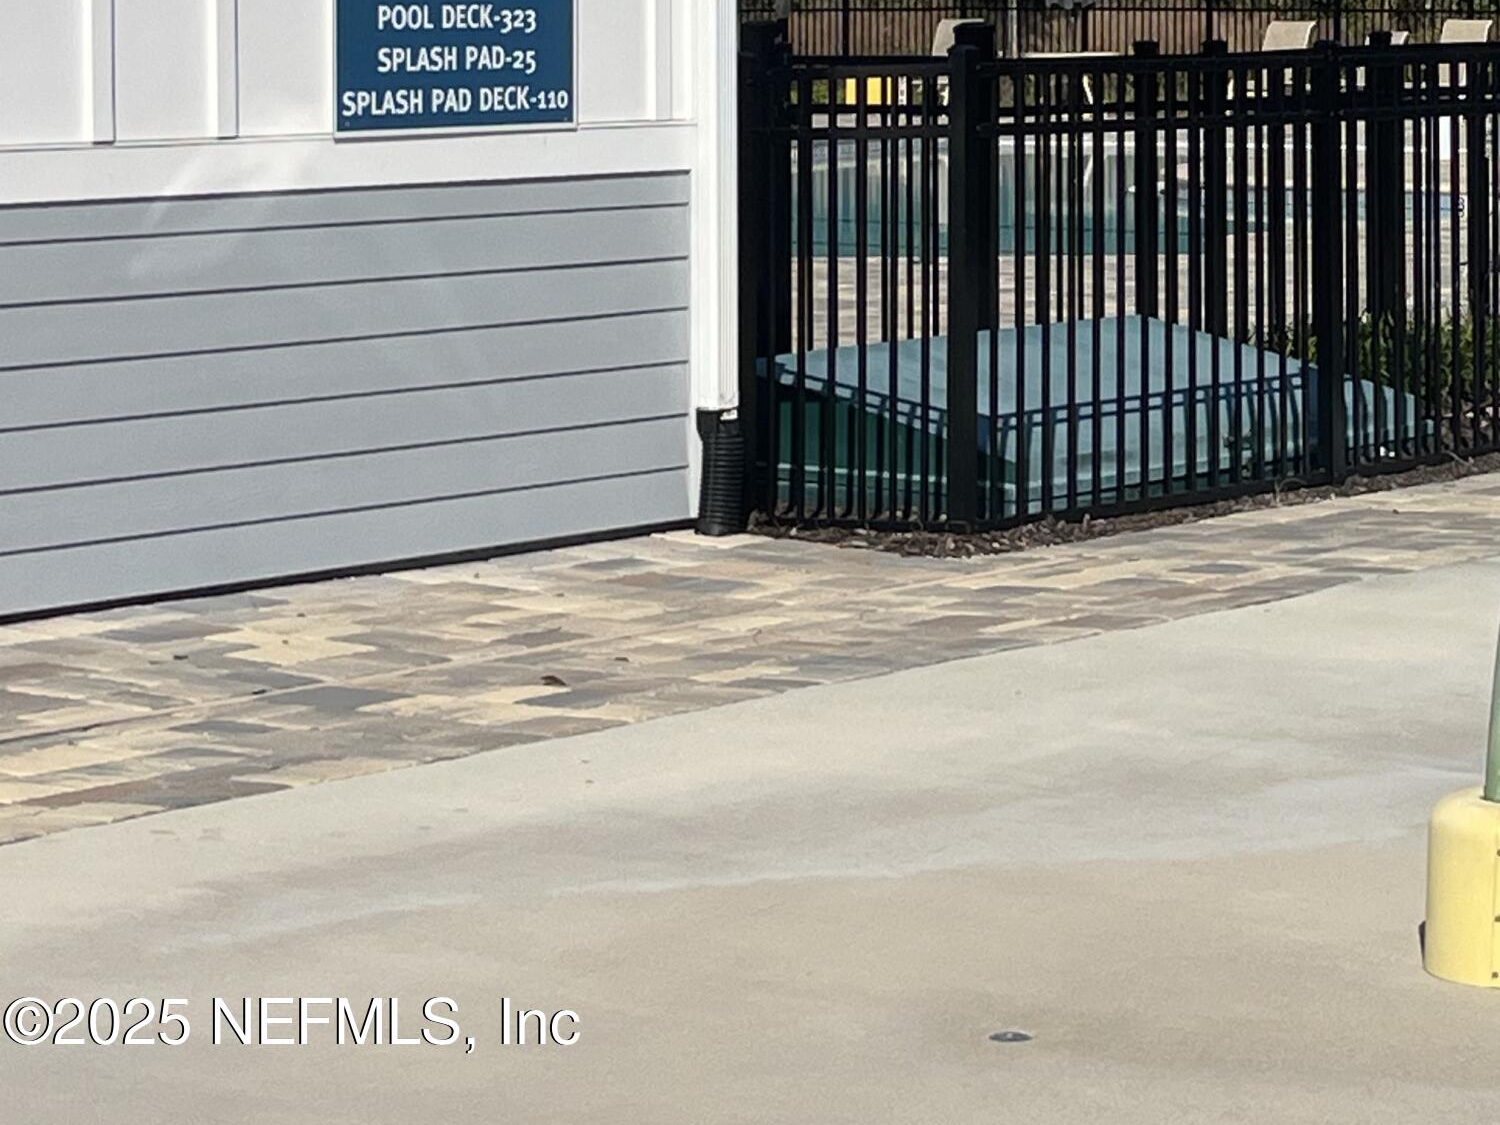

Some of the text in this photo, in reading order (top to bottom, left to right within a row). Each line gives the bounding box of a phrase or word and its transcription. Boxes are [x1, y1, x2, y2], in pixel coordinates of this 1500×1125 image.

[377, 3, 537, 33] POOL DECK-323
[377, 45, 536, 74] SPLASH PAD-25
[342, 85, 569, 117] SPLASH PAD DECK-110
